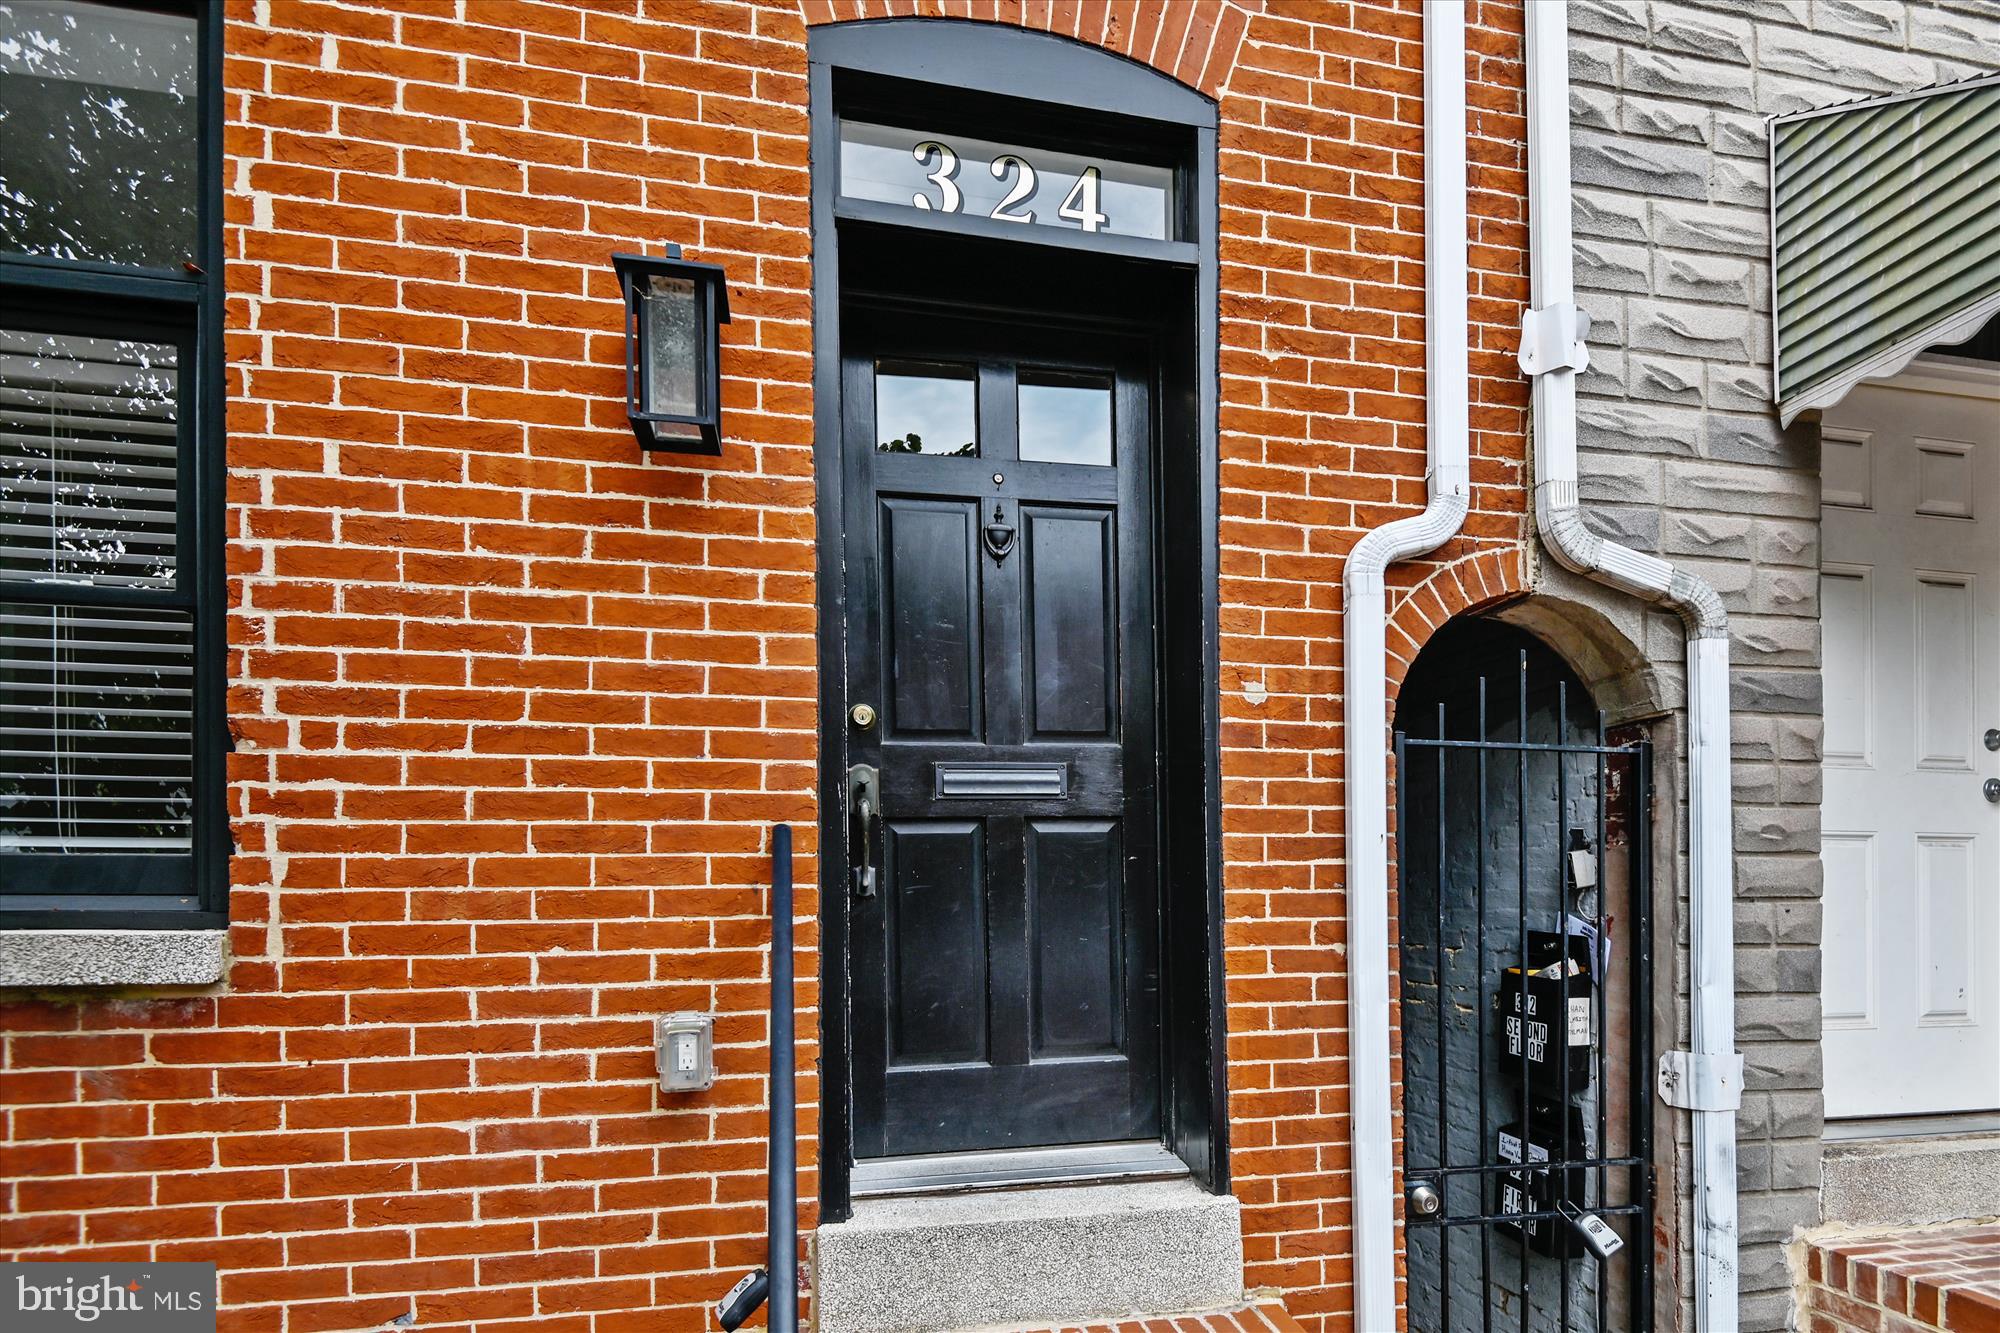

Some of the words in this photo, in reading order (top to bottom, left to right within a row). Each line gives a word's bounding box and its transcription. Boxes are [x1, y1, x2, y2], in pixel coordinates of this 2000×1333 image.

[912, 140, 1110, 233] 324
[1515, 993, 1536, 1014] 32
[1507, 1017, 1547, 1042] SEOND
[1510, 1037, 1542, 1062] FLOR
[1504, 1185, 1537, 1213] FIRT
